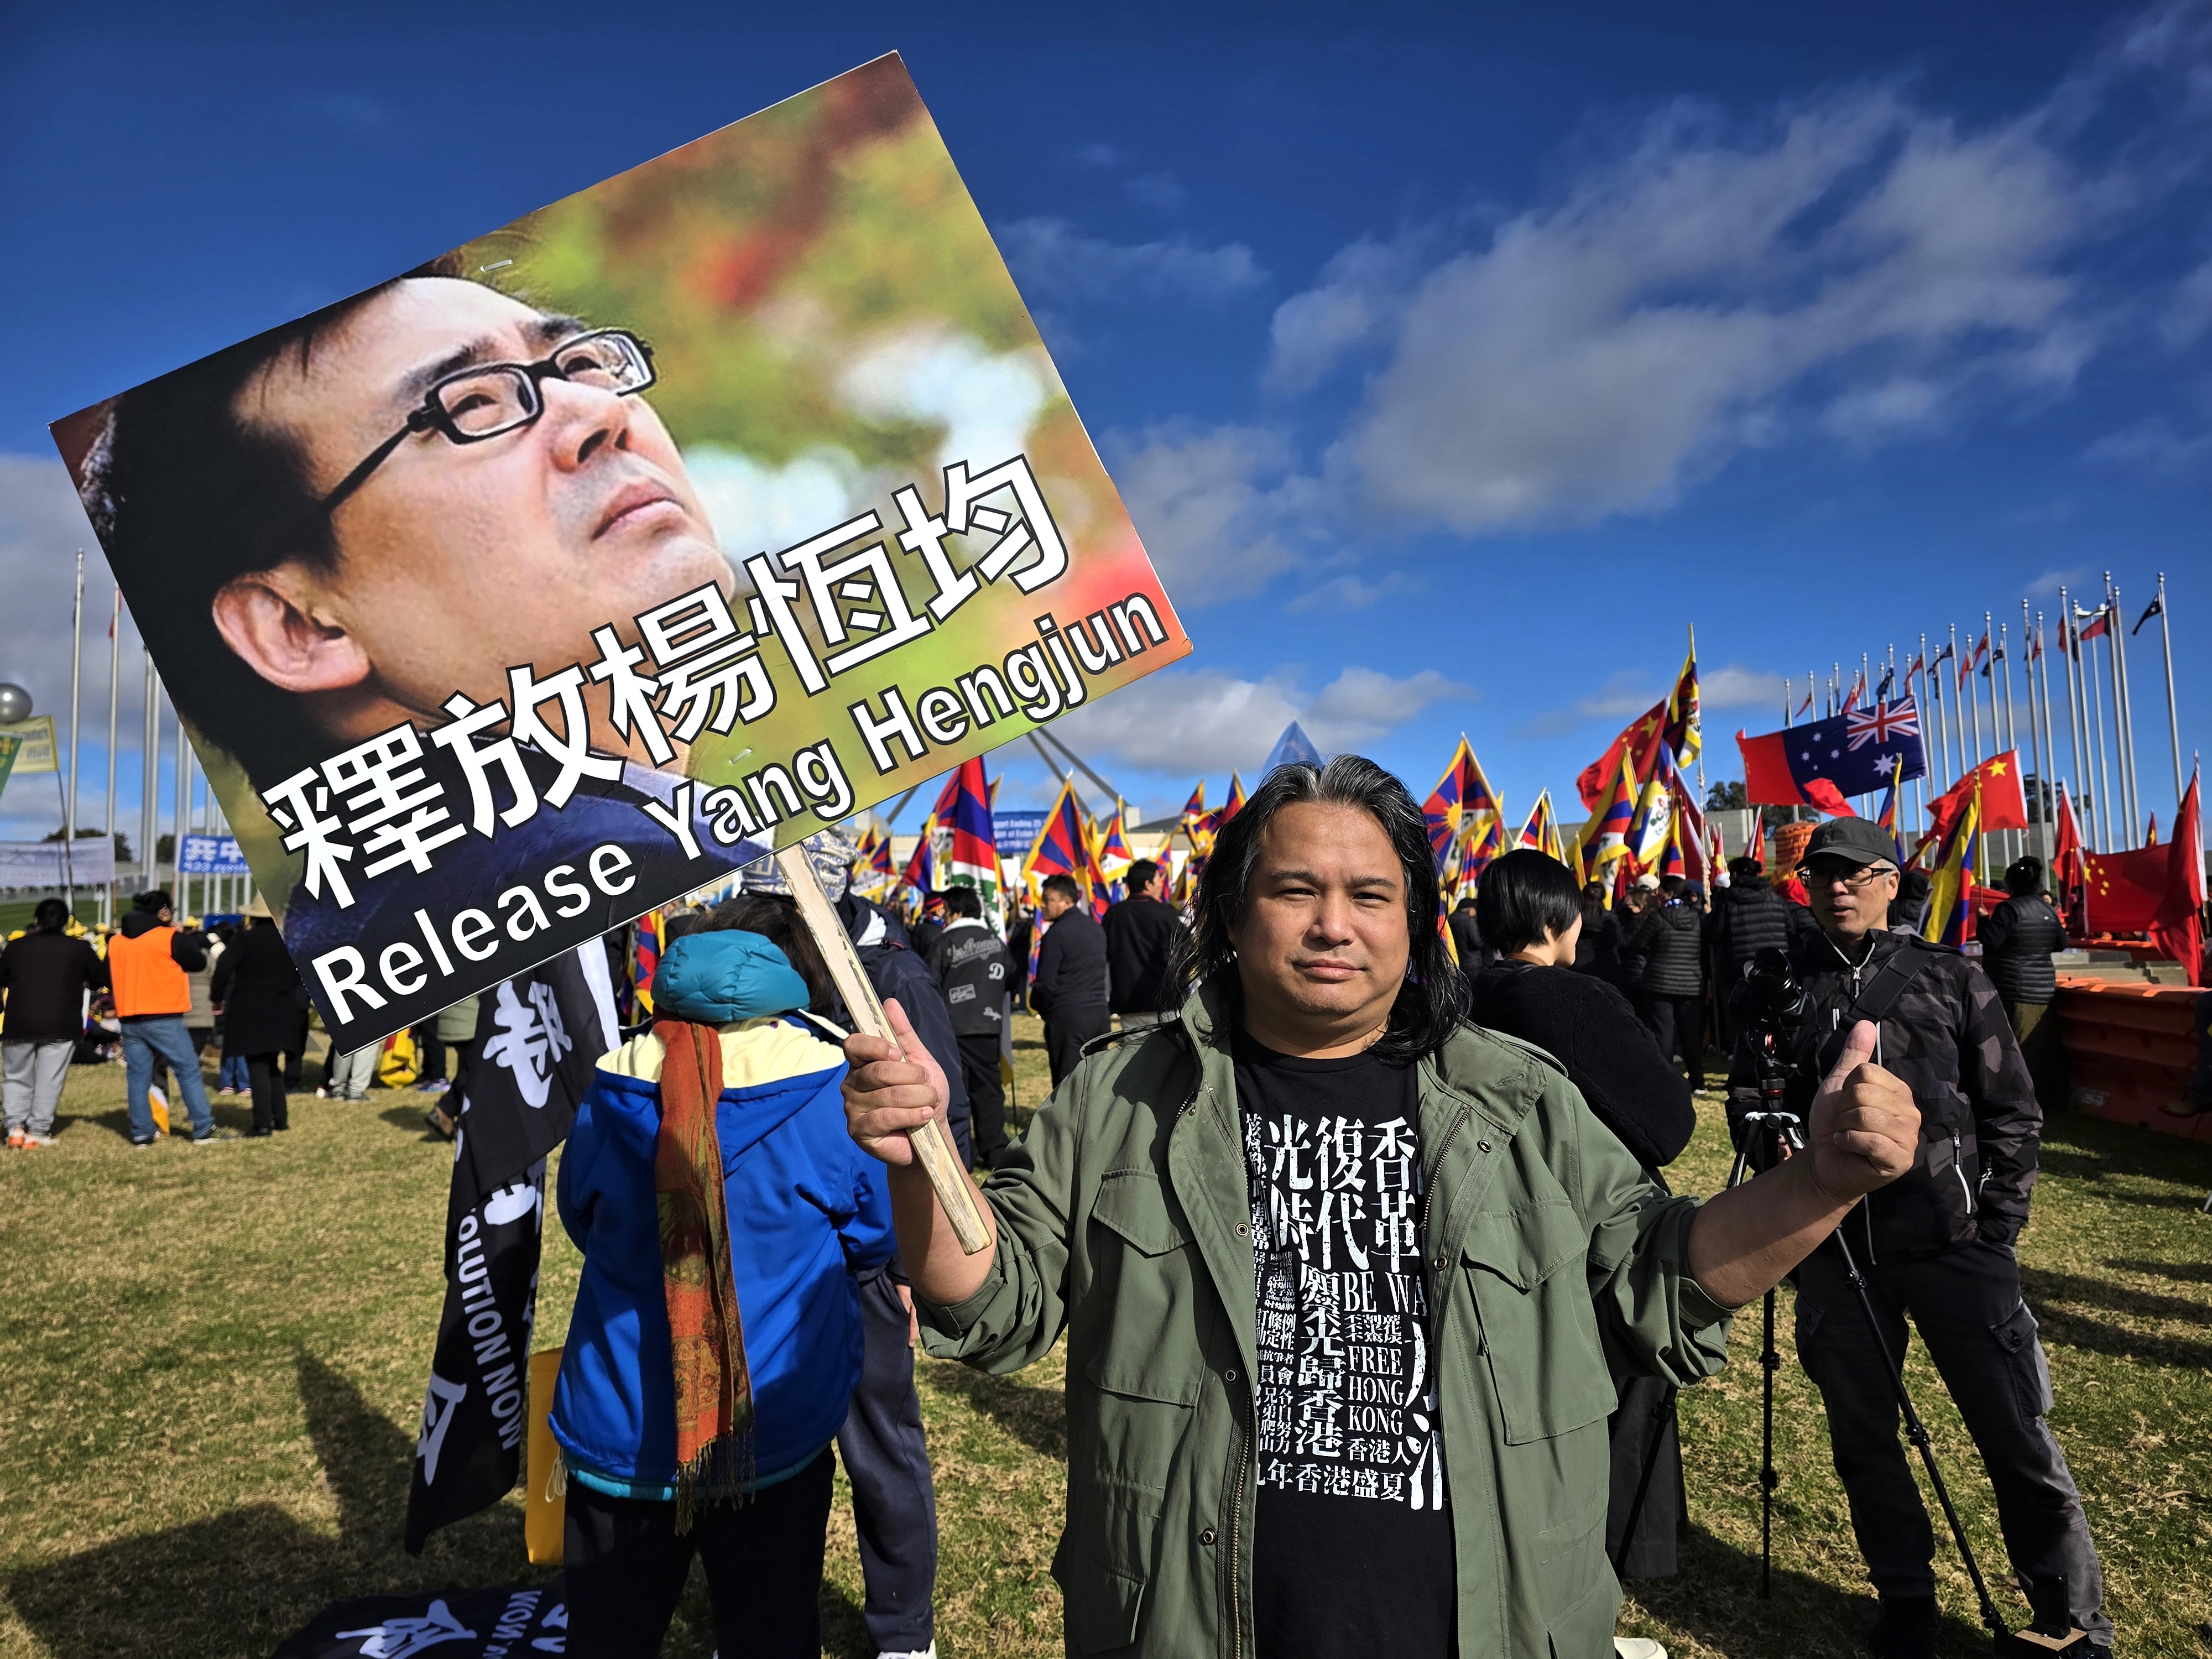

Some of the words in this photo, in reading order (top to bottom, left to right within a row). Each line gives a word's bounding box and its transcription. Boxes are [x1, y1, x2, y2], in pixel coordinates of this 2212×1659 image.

[311, 844, 637, 1026] Release
[643, 743, 852, 862] Yang
[851, 596, 1166, 771] Hengjun
[1264, 1114, 1425, 1192] 光復香
[1270, 1183, 1426, 1273] 時代革
[456, 1207, 512, 1366] OLUTION
[1342, 1271, 1377, 1313] BE
[1258, 1364, 1295, 1386] 員會
[1347, 1345, 1403, 1376] FREE
[483, 1371, 521, 1452] NOW
[1348, 1375, 1404, 1406] HONG
[1348, 1405, 1404, 1436] KONG
[1347, 1437, 1412, 1466] 香港人
